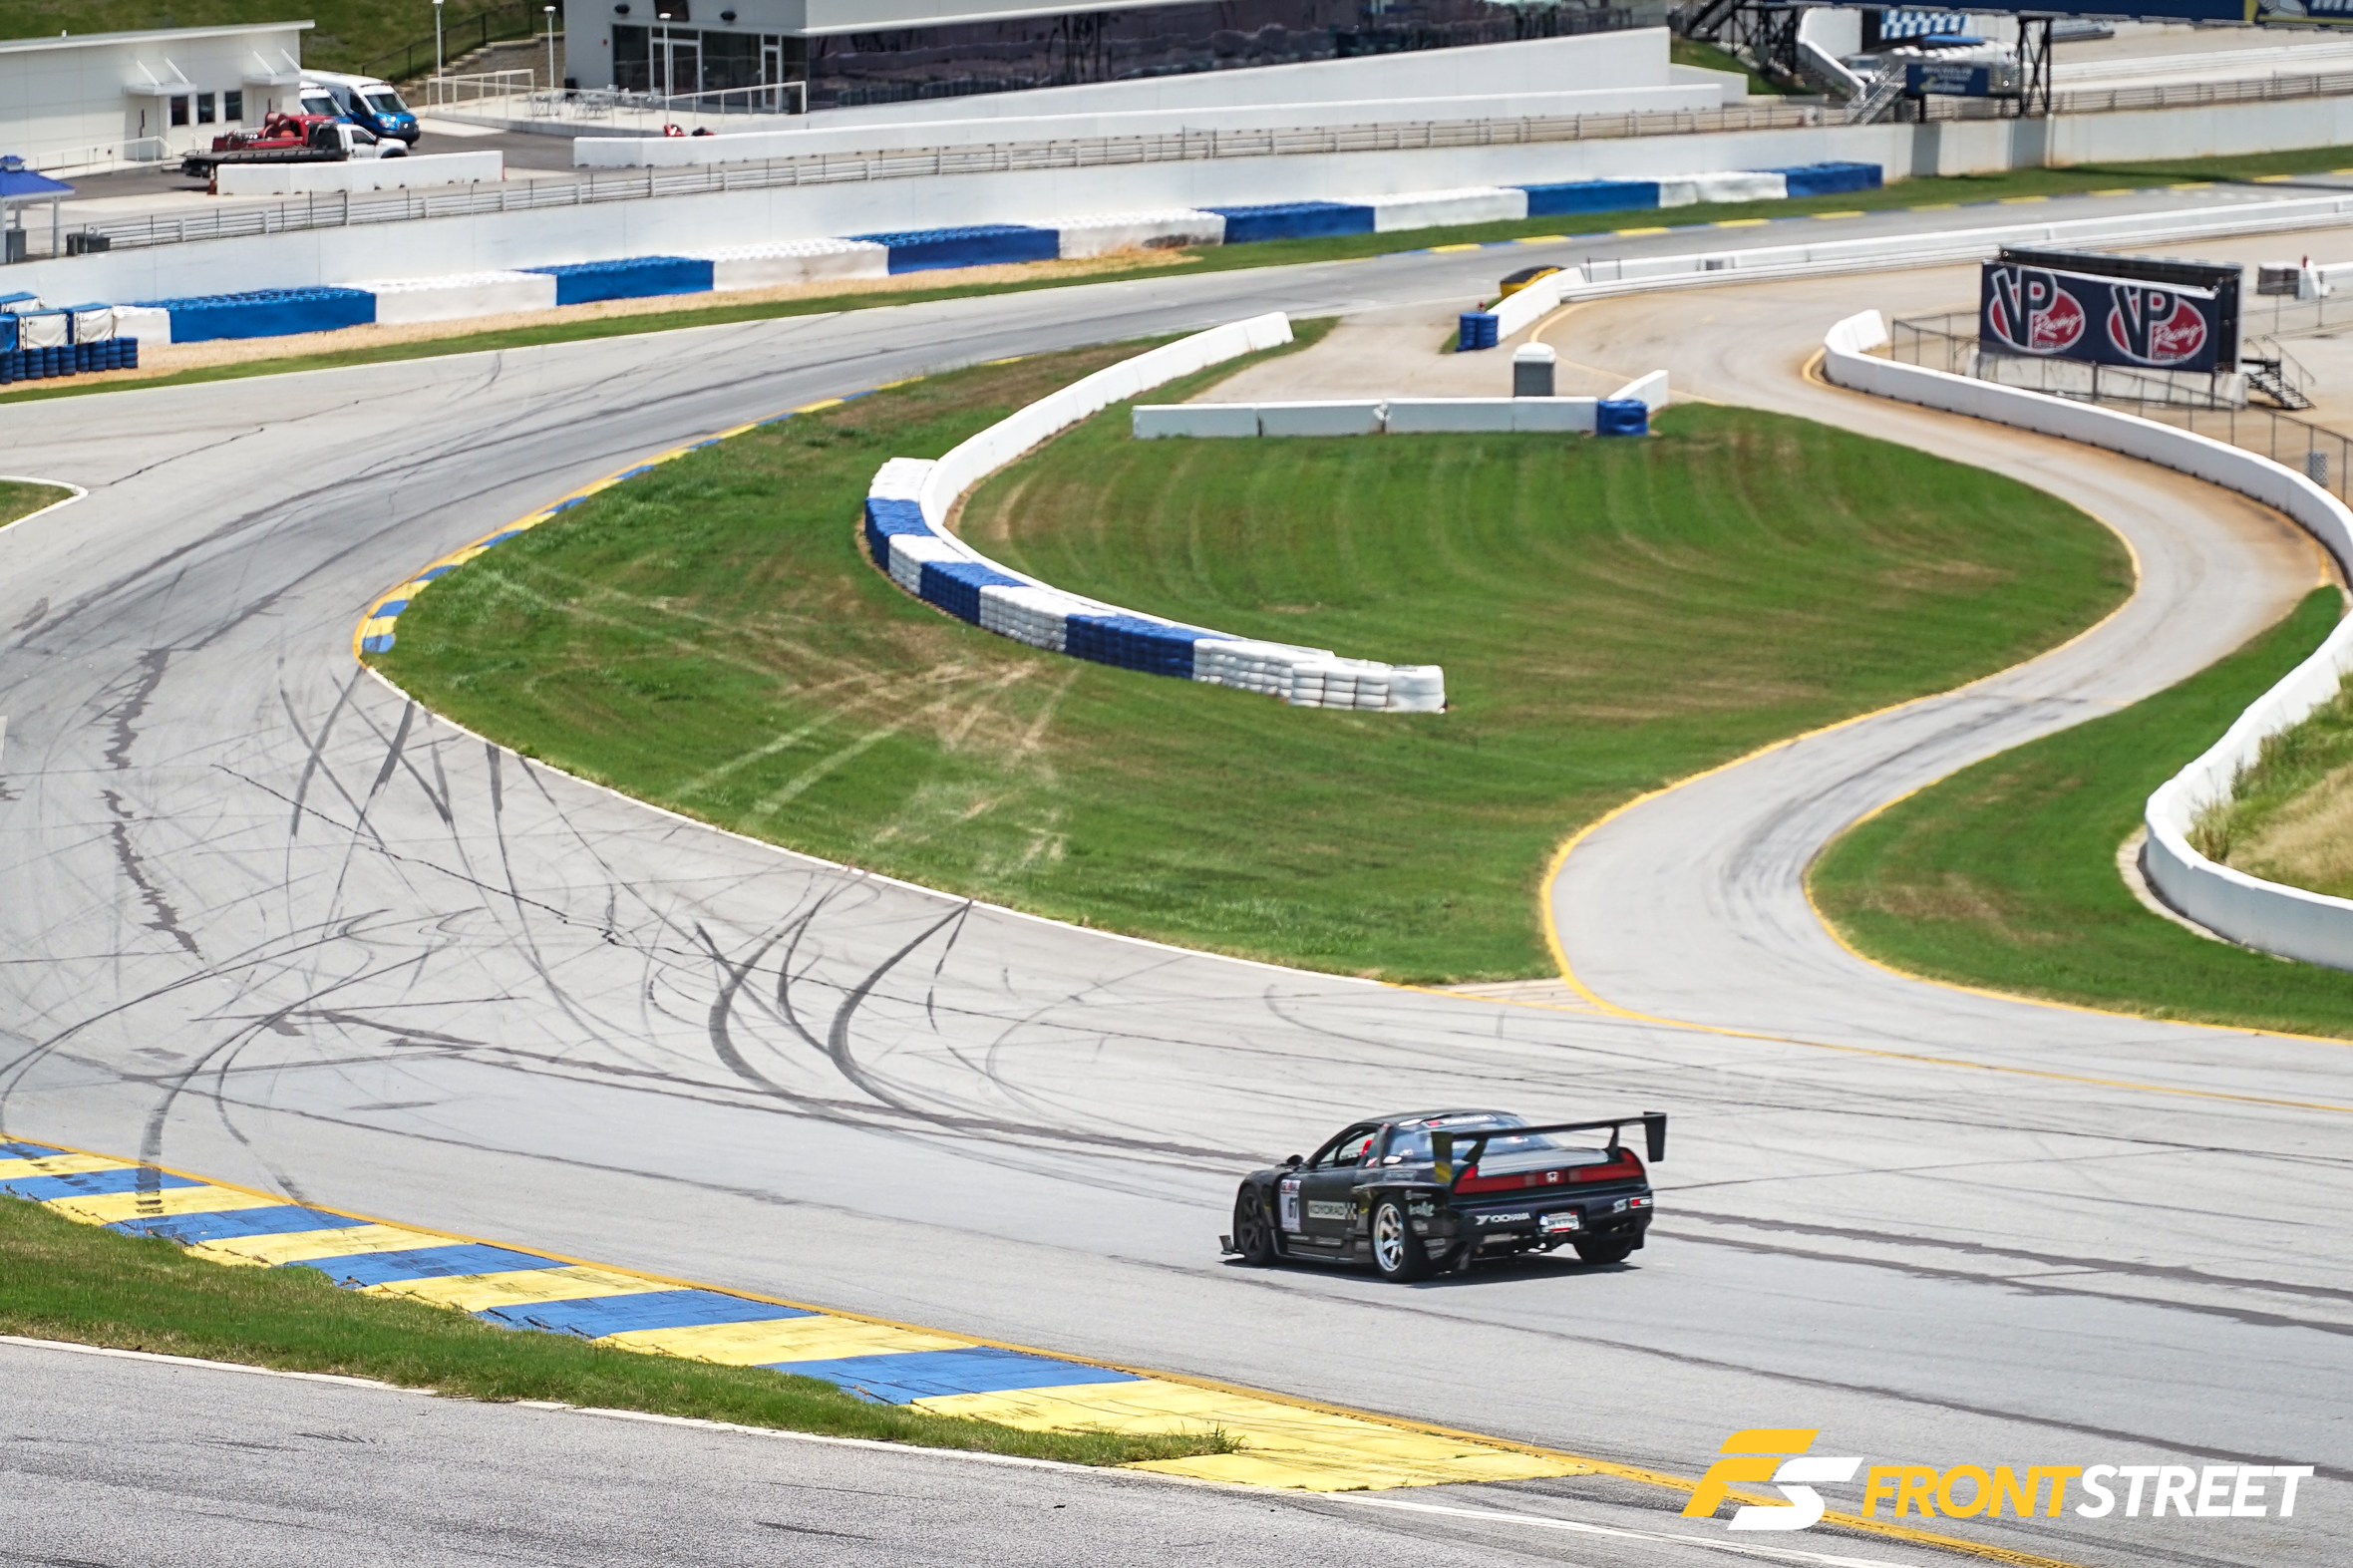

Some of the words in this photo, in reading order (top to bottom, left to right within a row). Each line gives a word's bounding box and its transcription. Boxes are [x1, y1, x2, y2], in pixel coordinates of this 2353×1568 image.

[1991, 267, 2058, 349] VP
[2034, 312, 2083, 340] Racing
[2110, 284, 2179, 360] VP
[2154, 322, 2203, 352] Racing
